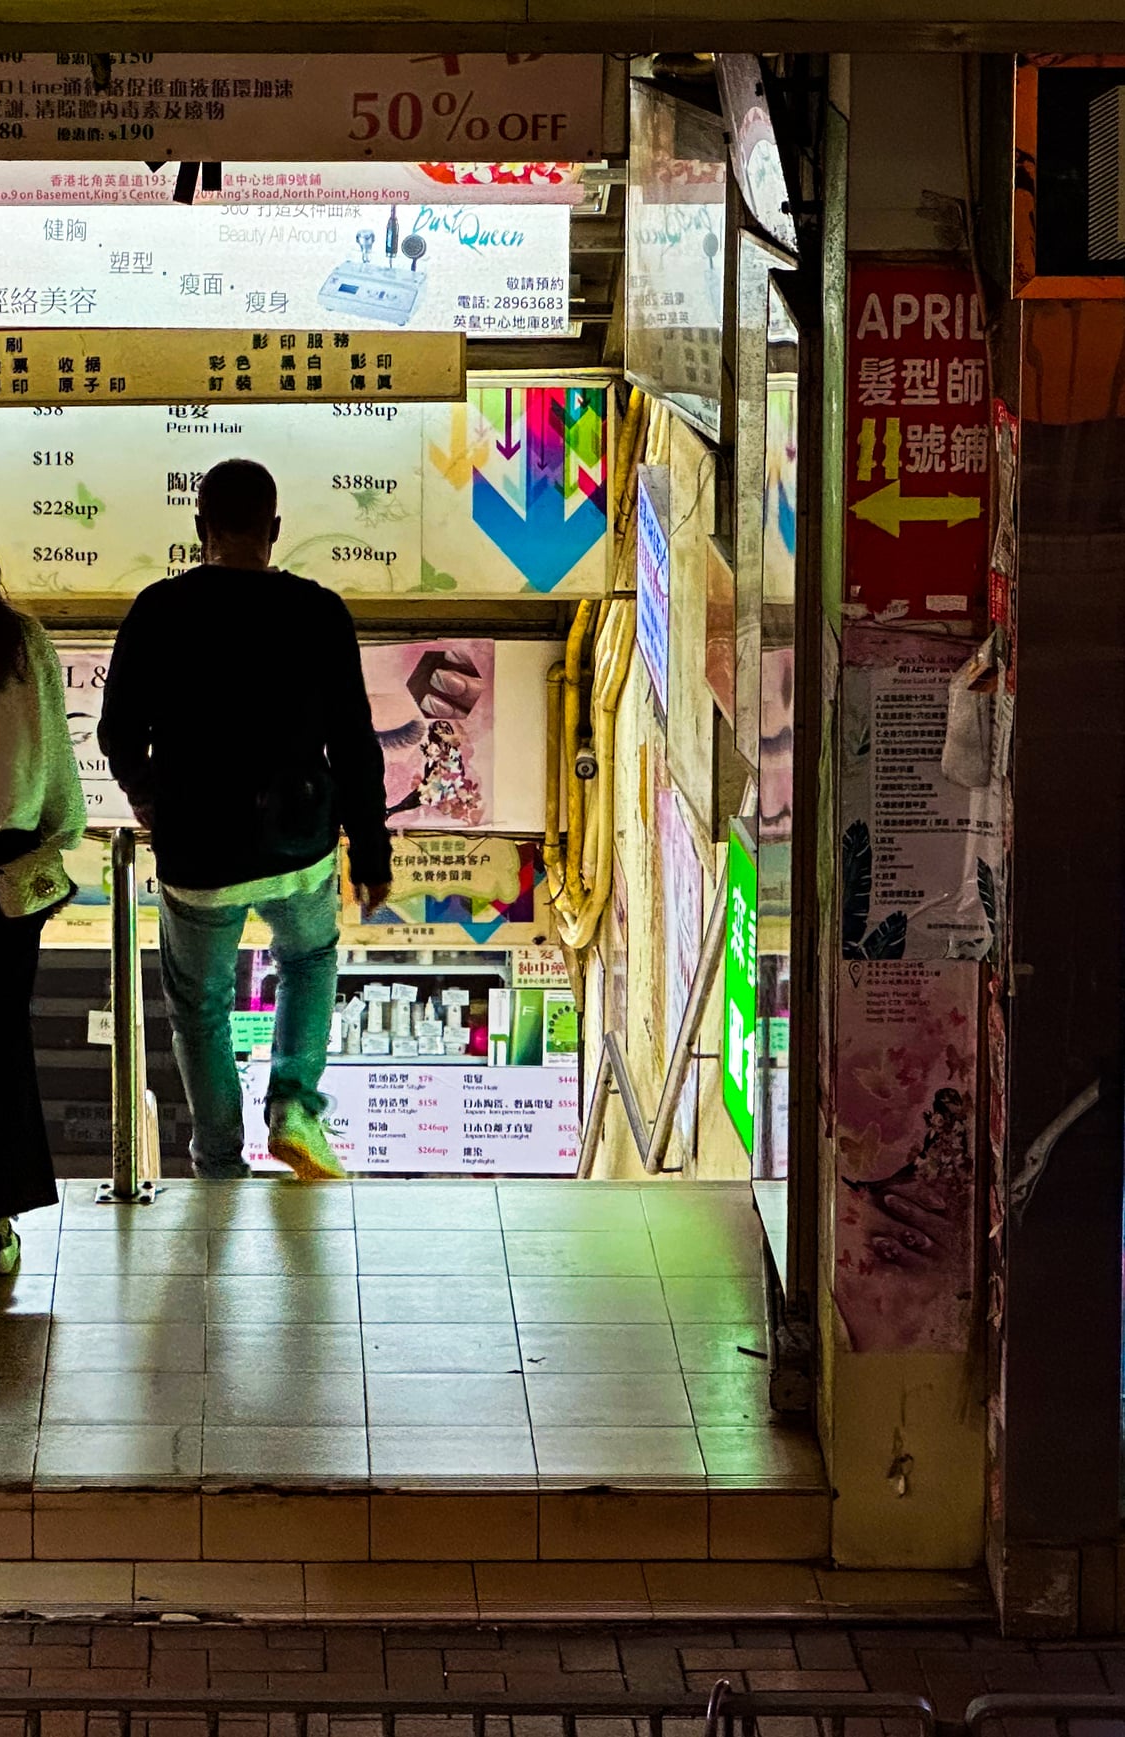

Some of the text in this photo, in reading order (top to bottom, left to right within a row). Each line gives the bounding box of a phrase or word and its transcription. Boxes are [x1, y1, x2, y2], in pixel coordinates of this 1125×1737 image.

[348, 90, 568, 142] 50% OFF
[108, 123, 154, 141] $190
[20, 192, 33, 200] on
[381, 189, 410, 203] Kong
[42, 218, 87, 242] 健胸
[218, 224, 337, 246] Beauty All Around
[459, 211, 525, 256] Queen
[109, 251, 154, 276] 塑型
[179, 273, 223, 297] 瘦面
[506, 277, 565, 292] 敬請預約
[245, 291, 289, 314] 瘦身
[457, 295, 564, 310] 電話: 28963683
[453, 314, 565, 330] 英皇中心地庫8號
[280, 354, 322, 371] 黑白
[350, 353, 393, 371] 影印
[58, 376, 126, 393] 原子印
[857, 355, 986, 407] 髮型師
[166, 422, 243, 434] Perm Hair
[33, 450, 74, 466] $118
[332, 474, 398, 494] $388up
[33, 500, 99, 520] $228up
[33, 546, 99, 566] $268up
[331, 546, 397, 566] $398up
